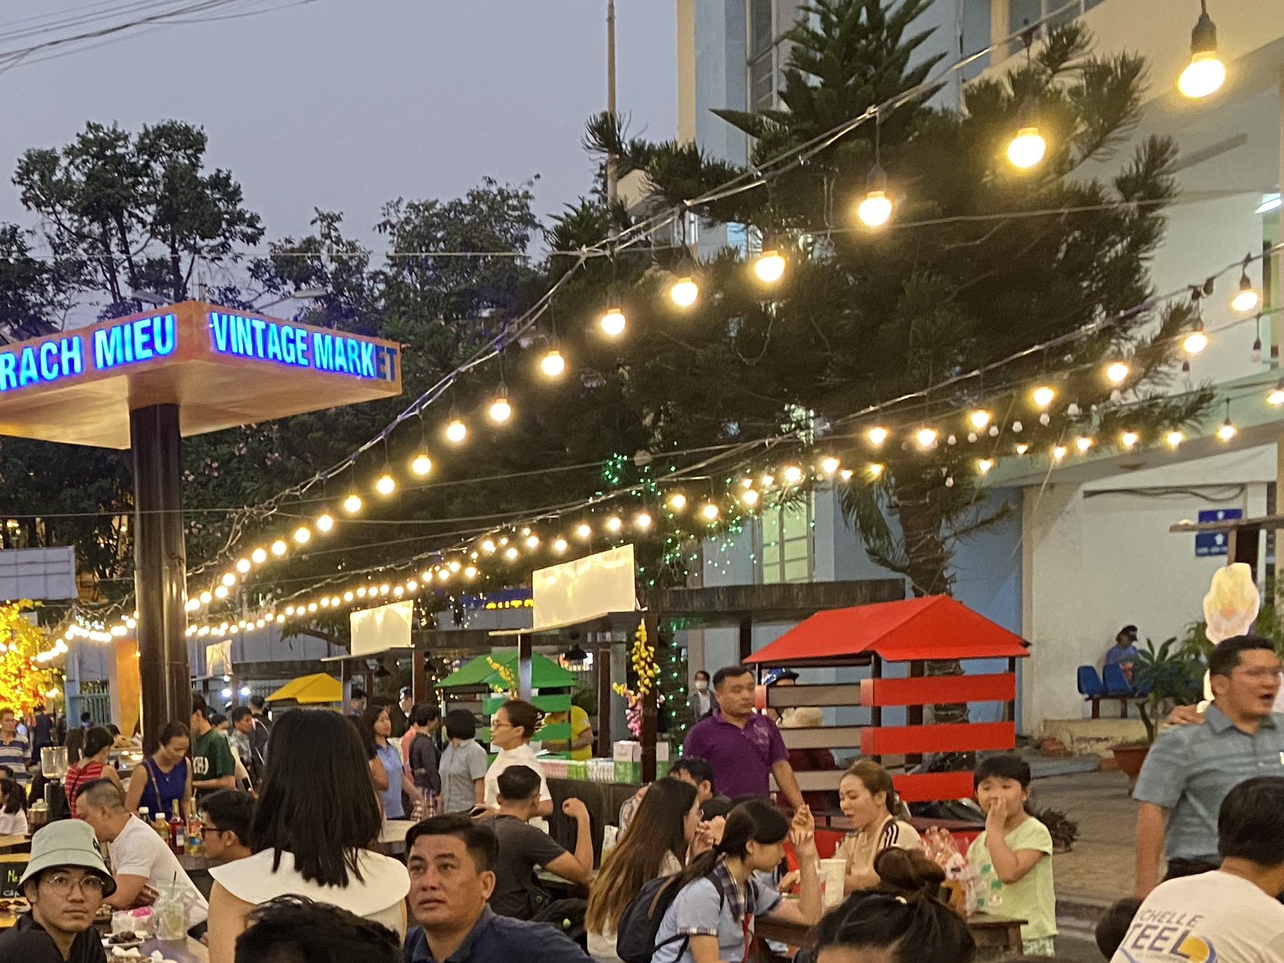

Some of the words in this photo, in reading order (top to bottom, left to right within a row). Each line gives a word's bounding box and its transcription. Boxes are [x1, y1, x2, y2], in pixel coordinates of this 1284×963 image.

[94, 313, 176, 370] MIEU
[210, 312, 310, 367] VINTAGE
[313, 331, 398, 382] MARKET
[1120, 922, 1191, 959] TEEL
[1138, 908, 1205, 928] CHELLE
